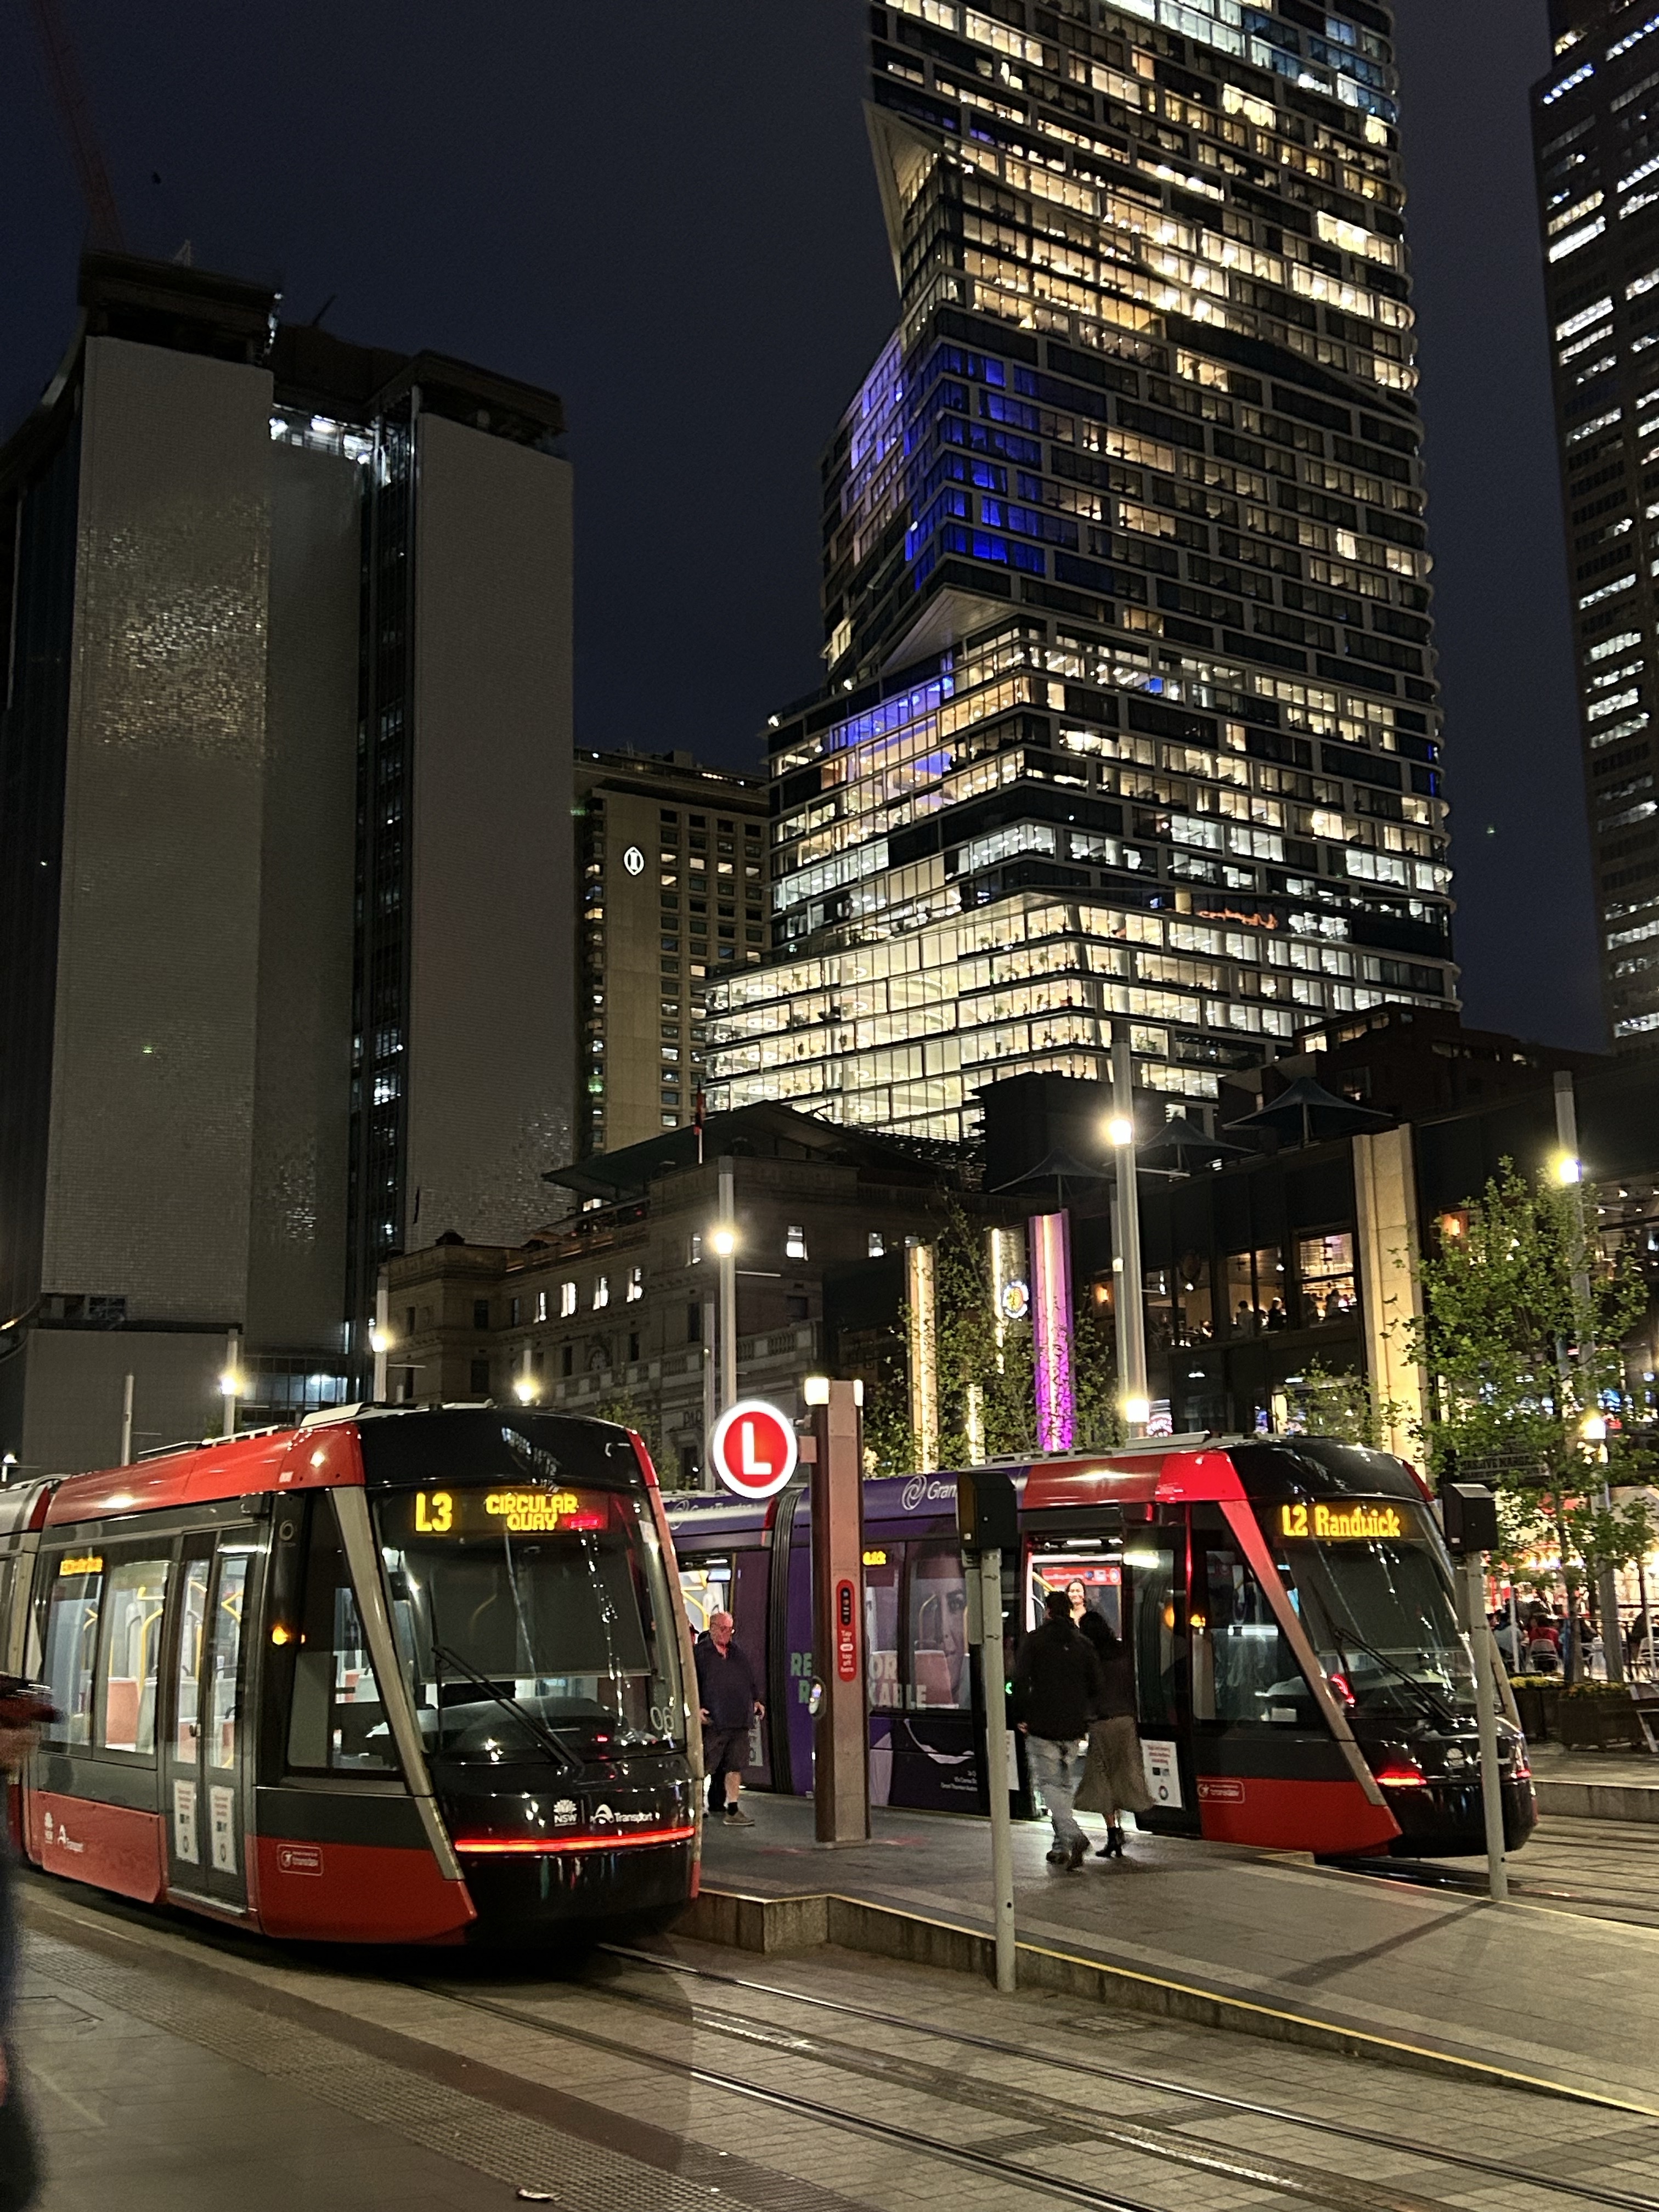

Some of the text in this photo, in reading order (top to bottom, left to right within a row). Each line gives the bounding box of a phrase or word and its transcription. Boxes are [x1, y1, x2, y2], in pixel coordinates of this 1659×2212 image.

[742, 1422, 772, 1475] L
[416, 1493, 578, 1531] L3 CIRCULAR
[507, 1513, 558, 1531] QUAY
[1282, 1505, 1401, 1537] L2 Randwick
[650, 1707, 674, 1734] 06
[554, 1812, 653, 1824] NSW Transport
